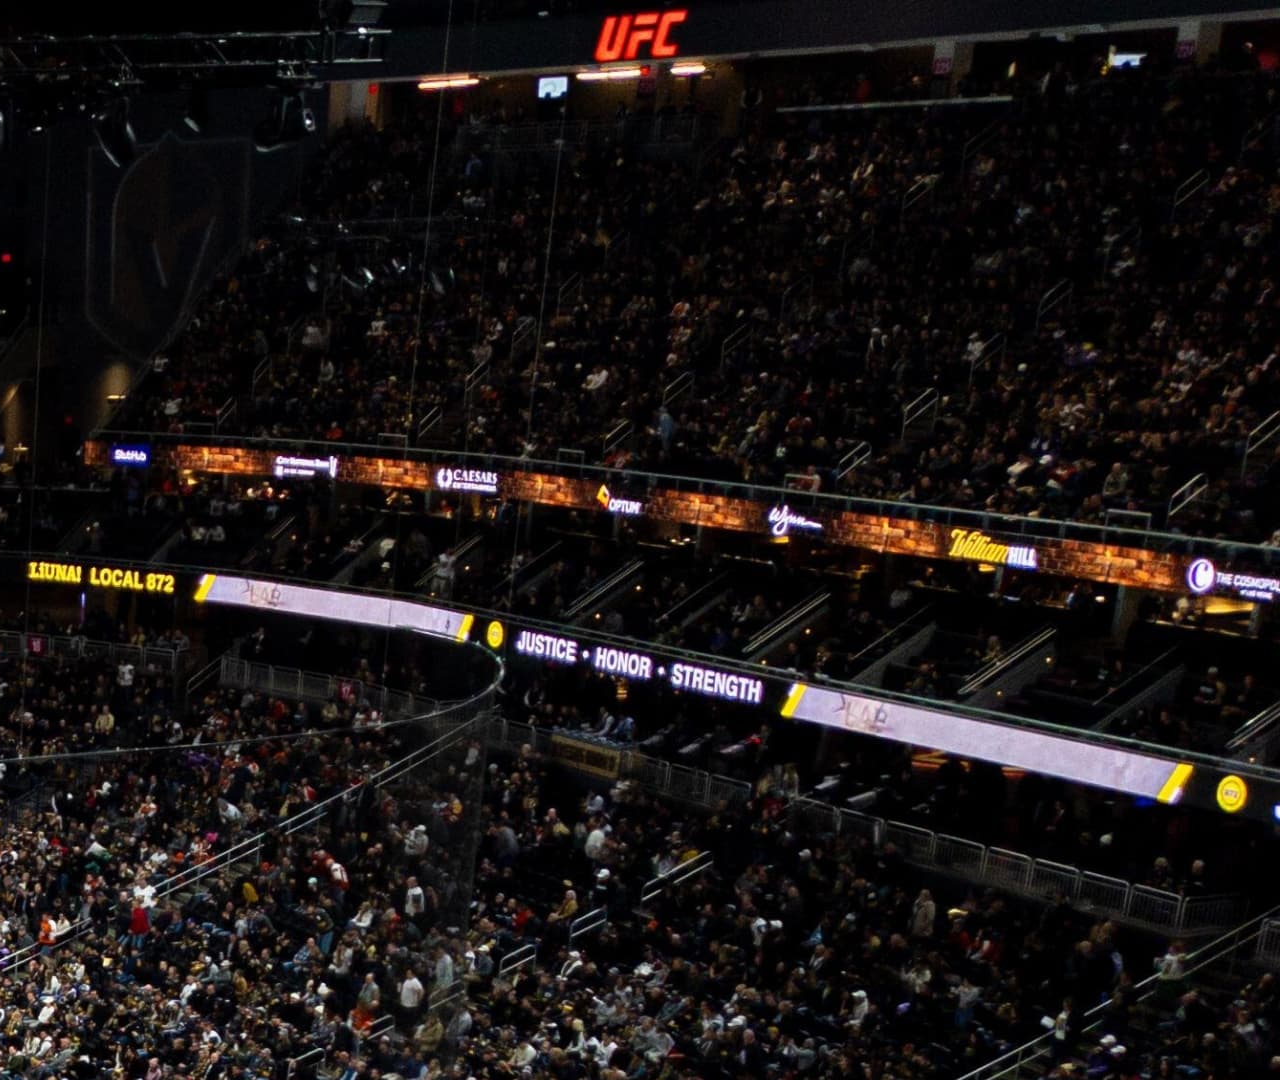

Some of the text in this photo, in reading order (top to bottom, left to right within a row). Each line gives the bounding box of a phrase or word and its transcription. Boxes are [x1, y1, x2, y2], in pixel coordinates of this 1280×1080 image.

[593, 9, 689, 62] UFC
[453, 469, 497, 484] CAESARS
[608, 500, 642, 514] OPTUM
[90, 567, 144, 589] LOCAL
[146, 573, 175, 593] 872
[517, 631, 762, 703] JUSTICE HONOR STRENGTH
